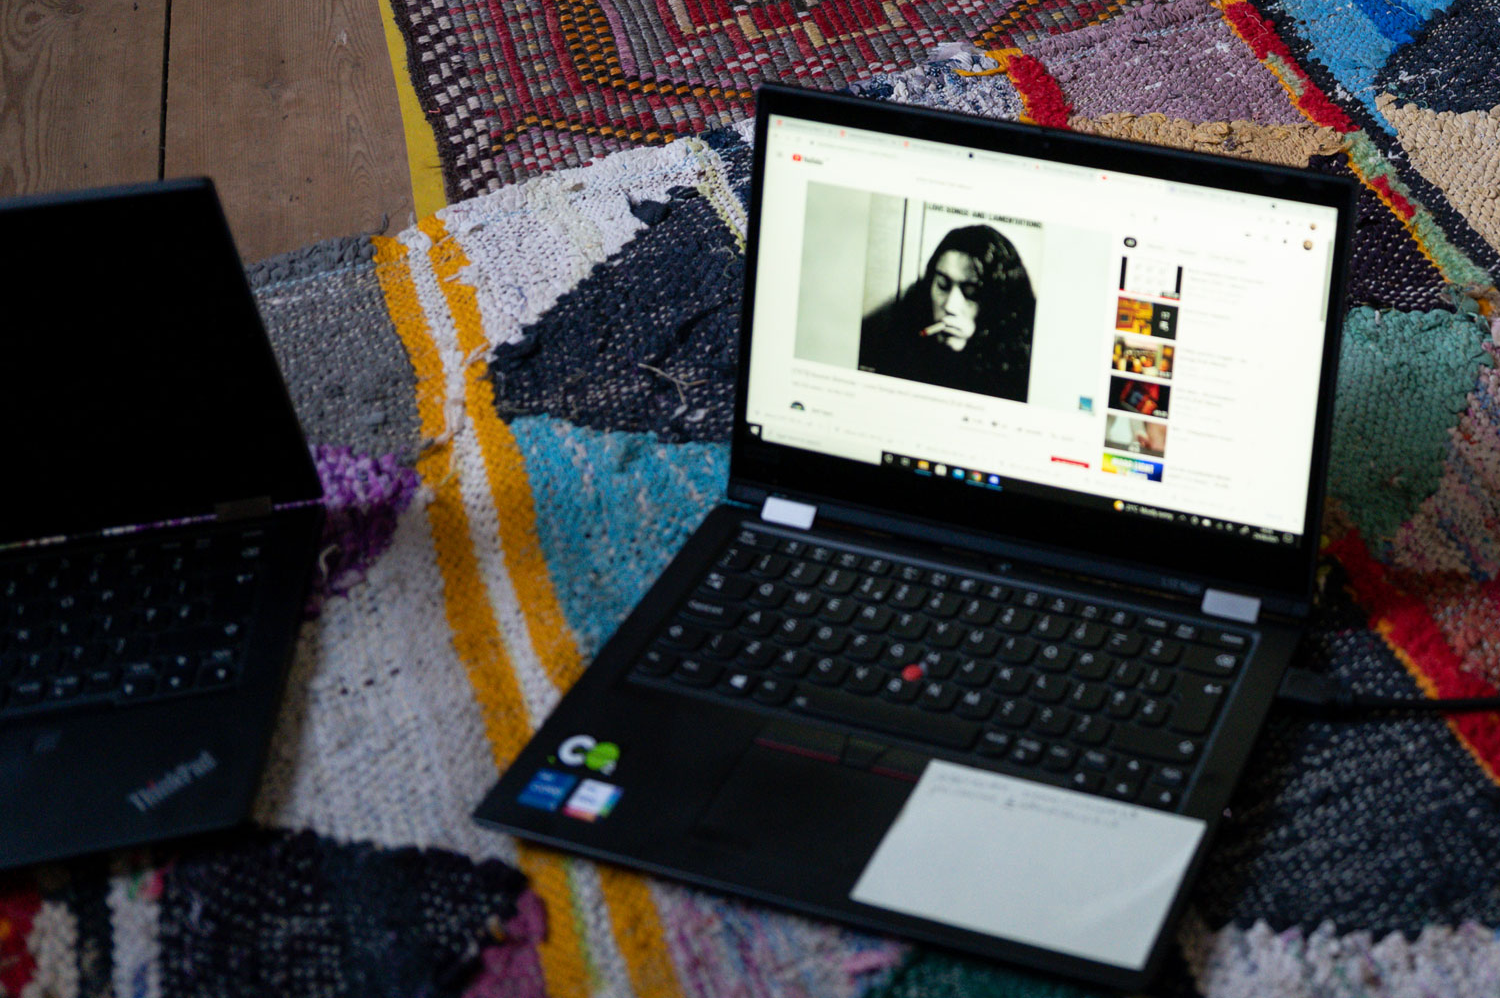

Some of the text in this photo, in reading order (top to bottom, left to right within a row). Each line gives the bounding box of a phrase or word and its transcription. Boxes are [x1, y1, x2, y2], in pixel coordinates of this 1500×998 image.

[927, 203, 943, 211] LOVE
[946, 206, 969, 216] SONGS
[972, 211, 985, 219] AND
